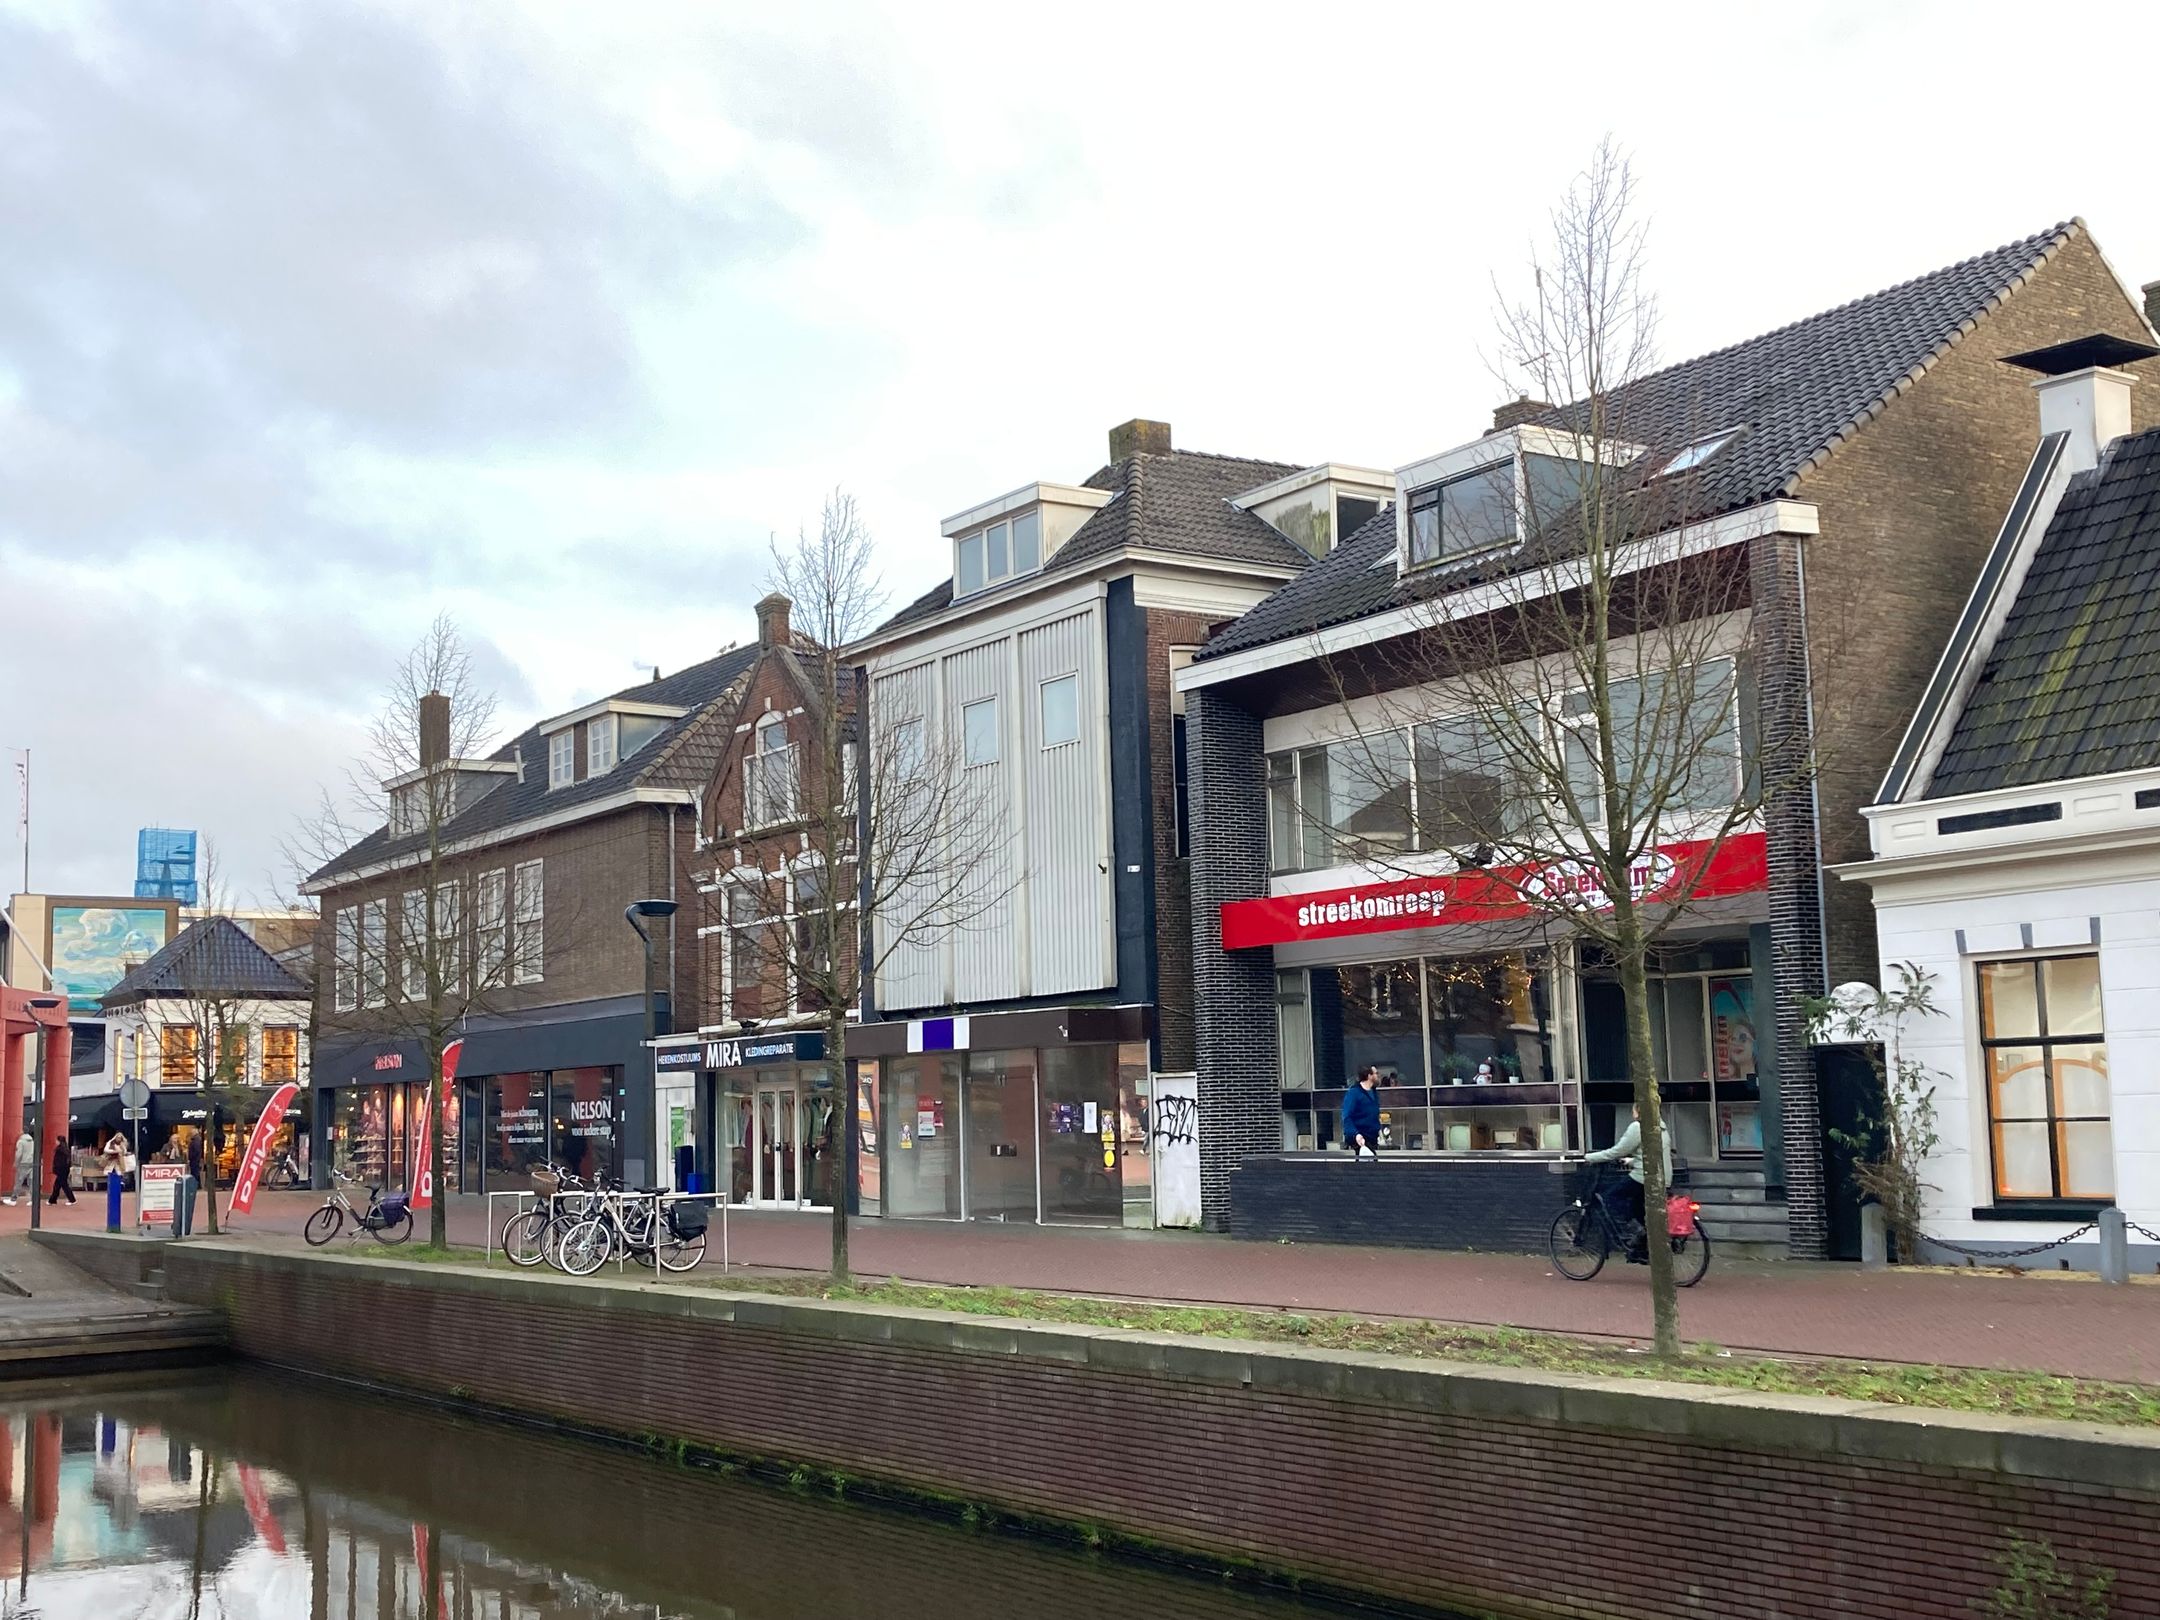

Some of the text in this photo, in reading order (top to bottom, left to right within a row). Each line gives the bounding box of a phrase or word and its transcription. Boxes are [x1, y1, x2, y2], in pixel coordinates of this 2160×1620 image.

[1298, 889, 1446, 926] streekomroep
[658, 1041, 793, 1068] HERENKOSTUUMS MIRA KLEDINGREPARATIE
[571, 1100, 612, 1121] NELSON
[571, 1127, 583, 1137] voor
[145, 1168, 182, 1179] MIRA
[240, 1122, 276, 1203] Mira
